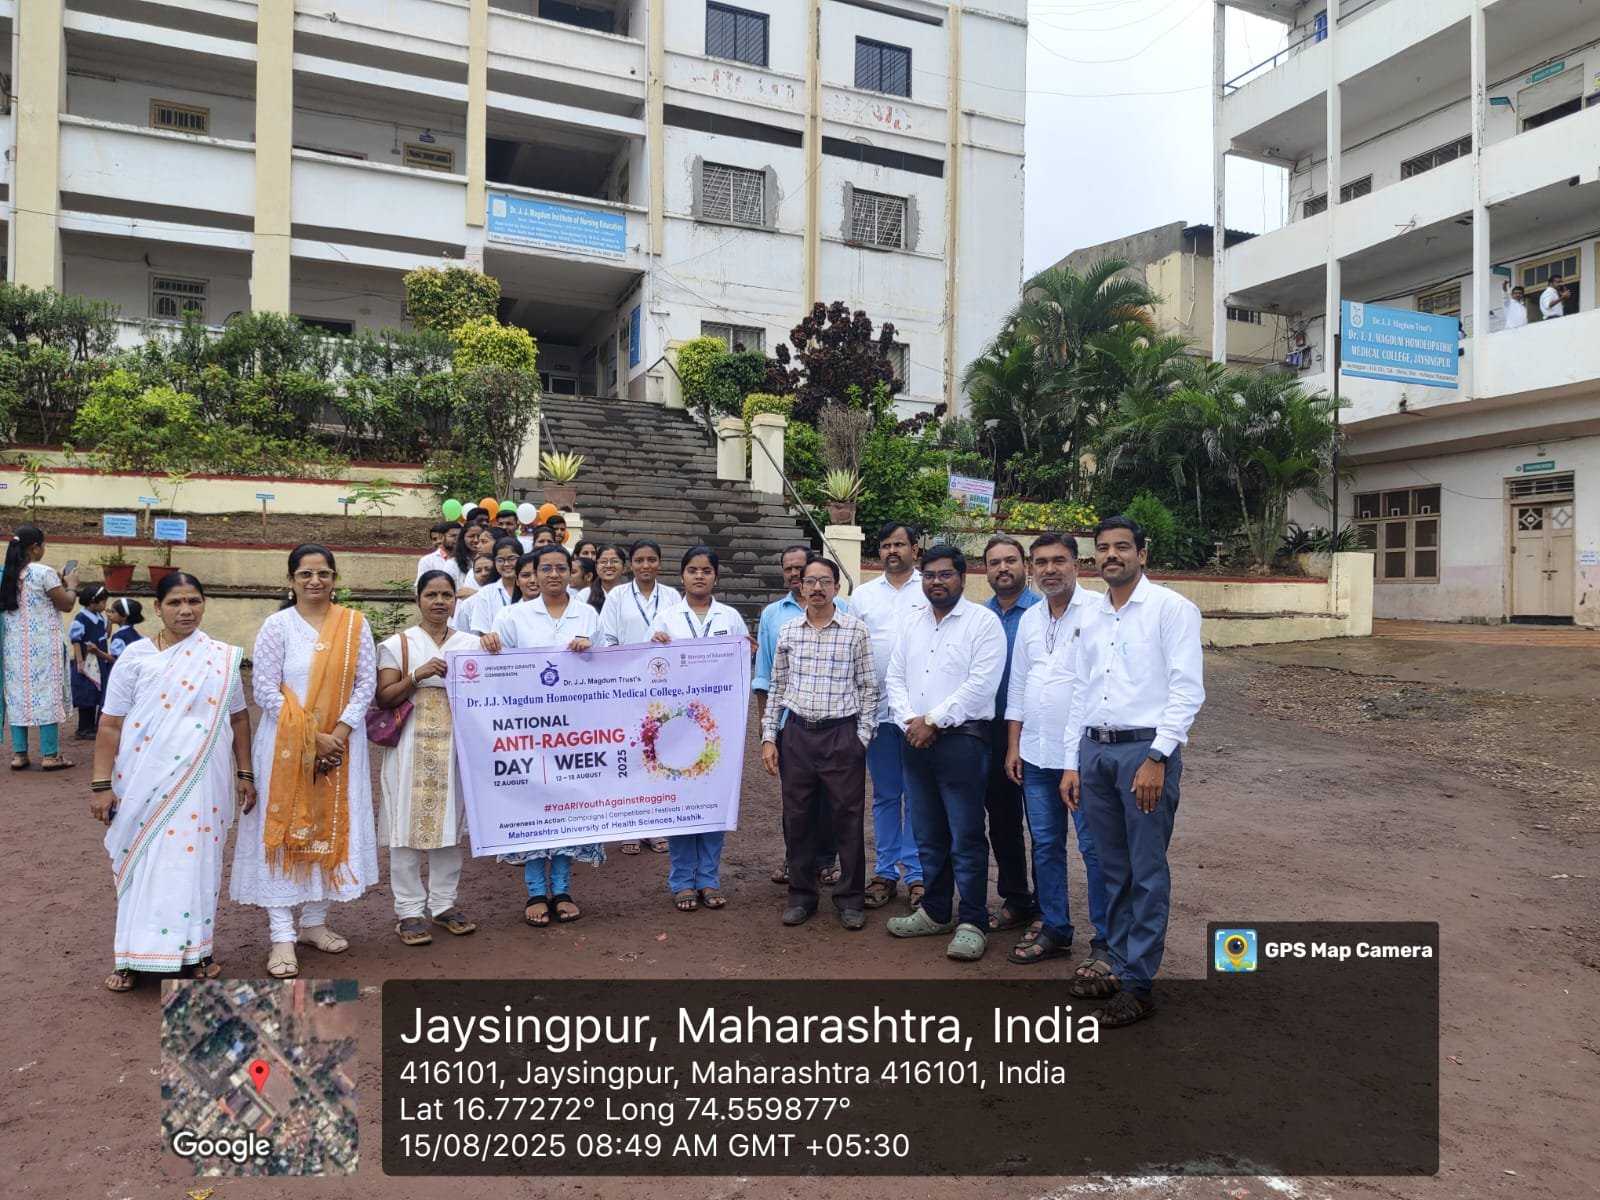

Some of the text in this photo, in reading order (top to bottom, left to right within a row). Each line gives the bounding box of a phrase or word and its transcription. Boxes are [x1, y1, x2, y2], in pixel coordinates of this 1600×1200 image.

[529, 208, 551, 220] Magdum
[551, 211, 573, 223] Institute
[573, 215, 580, 225] of
[580, 216, 599, 230] Nursing
[599, 219, 624, 232] Education
[1348, 328, 1359, 341] Dr.
[1375, 332, 1404, 347] MAGDUM
[1405, 337, 1454, 354] HOMOEOPATHIC
[1351, 345, 1452, 368] MEDICAL COLLEGE, JAYSINGPUR
[563, 675, 642, 687] Dr. J.J. Magdum Trust's
[467, 683, 734, 708] Dr. J.J. Magdum Homoeopathic Medical College, Jaysingpur
[492, 714, 570, 731] NATIONAL
[492, 727, 626, 752] ANTI-RAGGING
[494, 751, 608, 776] DAY WEEK
[576, 771, 602, 780] AUGUST
[617, 749, 628, 778] 2025
[502, 778, 529, 787] AUGUST
[499, 819, 536, 829] Awareness
[544, 816, 566, 825] Action:
[567, 812, 605, 823] Campaigns
[608, 808, 651, 819] Competitions
[654, 805, 681, 814] Festivals
[685, 802, 718, 811] Workshops
[508, 812, 705, 840] Maharashtra University of Health Sciences, Nashik.
